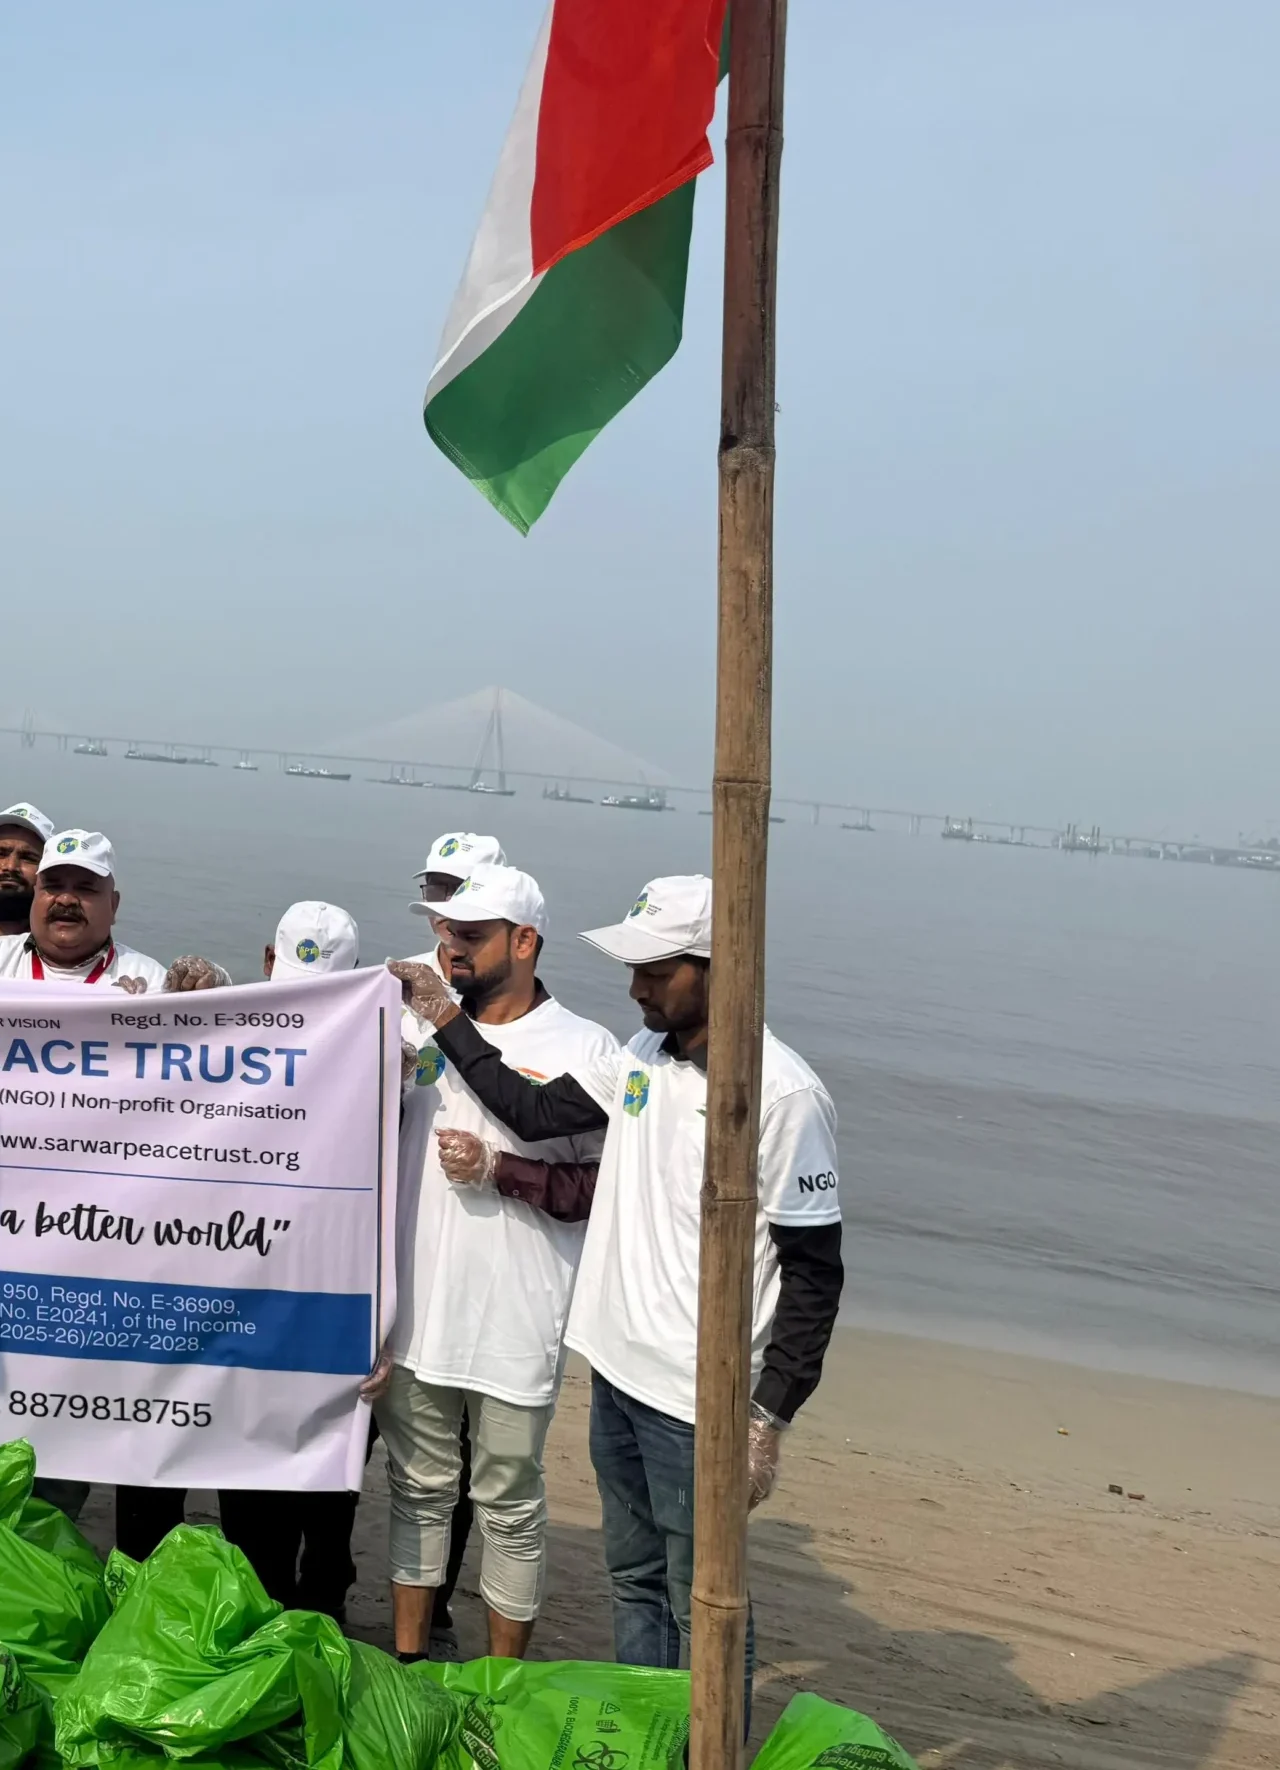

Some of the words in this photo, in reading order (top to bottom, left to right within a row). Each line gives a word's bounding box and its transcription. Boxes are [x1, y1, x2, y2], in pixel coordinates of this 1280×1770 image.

[8, 1016, 61, 1029] VISION
[111, 1012, 168, 1029] Regd.
[173, 1013, 208, 1027] No.
[214, 1013, 304, 1028] E-36909
[124, 1041, 306, 1086] TRUST
[0, 1089, 54, 1107] (NGO)
[72, 1093, 174, 1114] Non-profit
[180, 1099, 306, 1120] Organisation
[798, 1171, 836, 1193] NGO
[0, 1210, 25, 1234] a
[35, 1202, 144, 1243] better
[52, 1287, 106, 1308] Regd.
[114, 1292, 149, 1308] No.
[152, 1294, 240, 1315] E-36909,
[0, 1303, 29, 1319] No.
[37, 1303, 115, 1329] E20241,
[123, 1313, 140, 1328] of
[147, 1314, 176, 1331] the
[184, 1317, 256, 1334] Income
[9, 1391, 211, 1427] 8879818755
